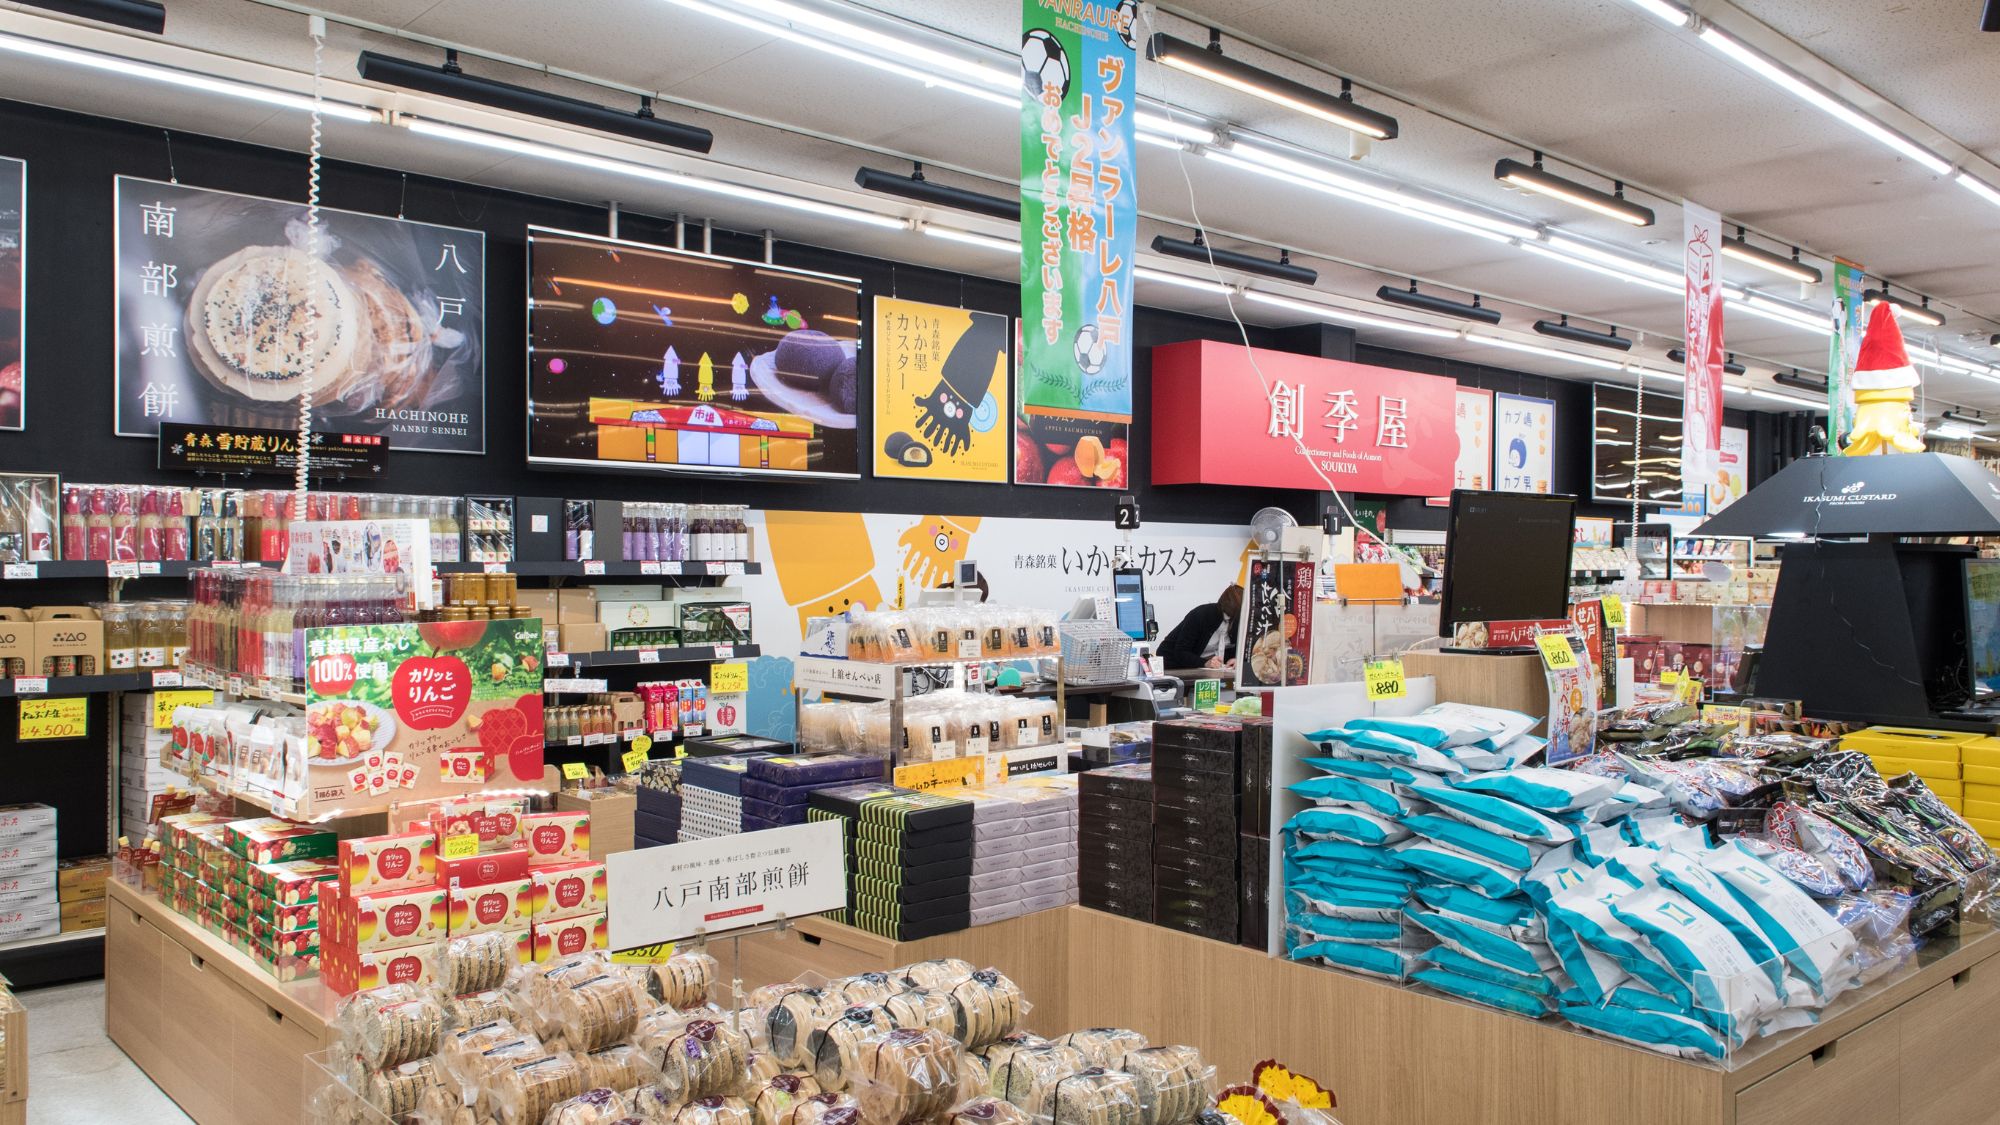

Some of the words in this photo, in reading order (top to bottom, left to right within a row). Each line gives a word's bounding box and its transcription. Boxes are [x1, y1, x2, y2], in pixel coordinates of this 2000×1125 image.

[1097, 55, 1124, 349] ヴァンラーレ八戸
[434, 243, 466, 324] 八戸
[138, 202, 178, 418] 南部煎餅
[897, 314, 909, 390] カスター
[914, 316, 928, 372] いか墨
[375, 408, 468, 424] HACHINOHE
[1268, 380, 1408, 448] 創季屋
[392, 424, 428, 434] NANBU
[431, 426, 468, 435] SENBEI
[184, 432, 214, 448] 青森
[1321, 461, 1358, 473] SOUKIYA
[1803, 494, 1847, 503] IKASUMI
[1120, 509, 1129, 525] 2
[1014, 554, 1057, 569] 青森銘菓
[514, 630, 539, 640] Calbee
[308, 635, 410, 656] 青森県産ふじ
[1551, 651, 1570, 664] 860
[409, 668, 454, 683] カリッと
[409, 684, 457, 703] りんご
[653, 862, 809, 911] 八戸南部煎餅
[482, 906, 501, 914] りんご
[394, 916, 414, 925] りんご
[394, 970, 414, 978] りんご
